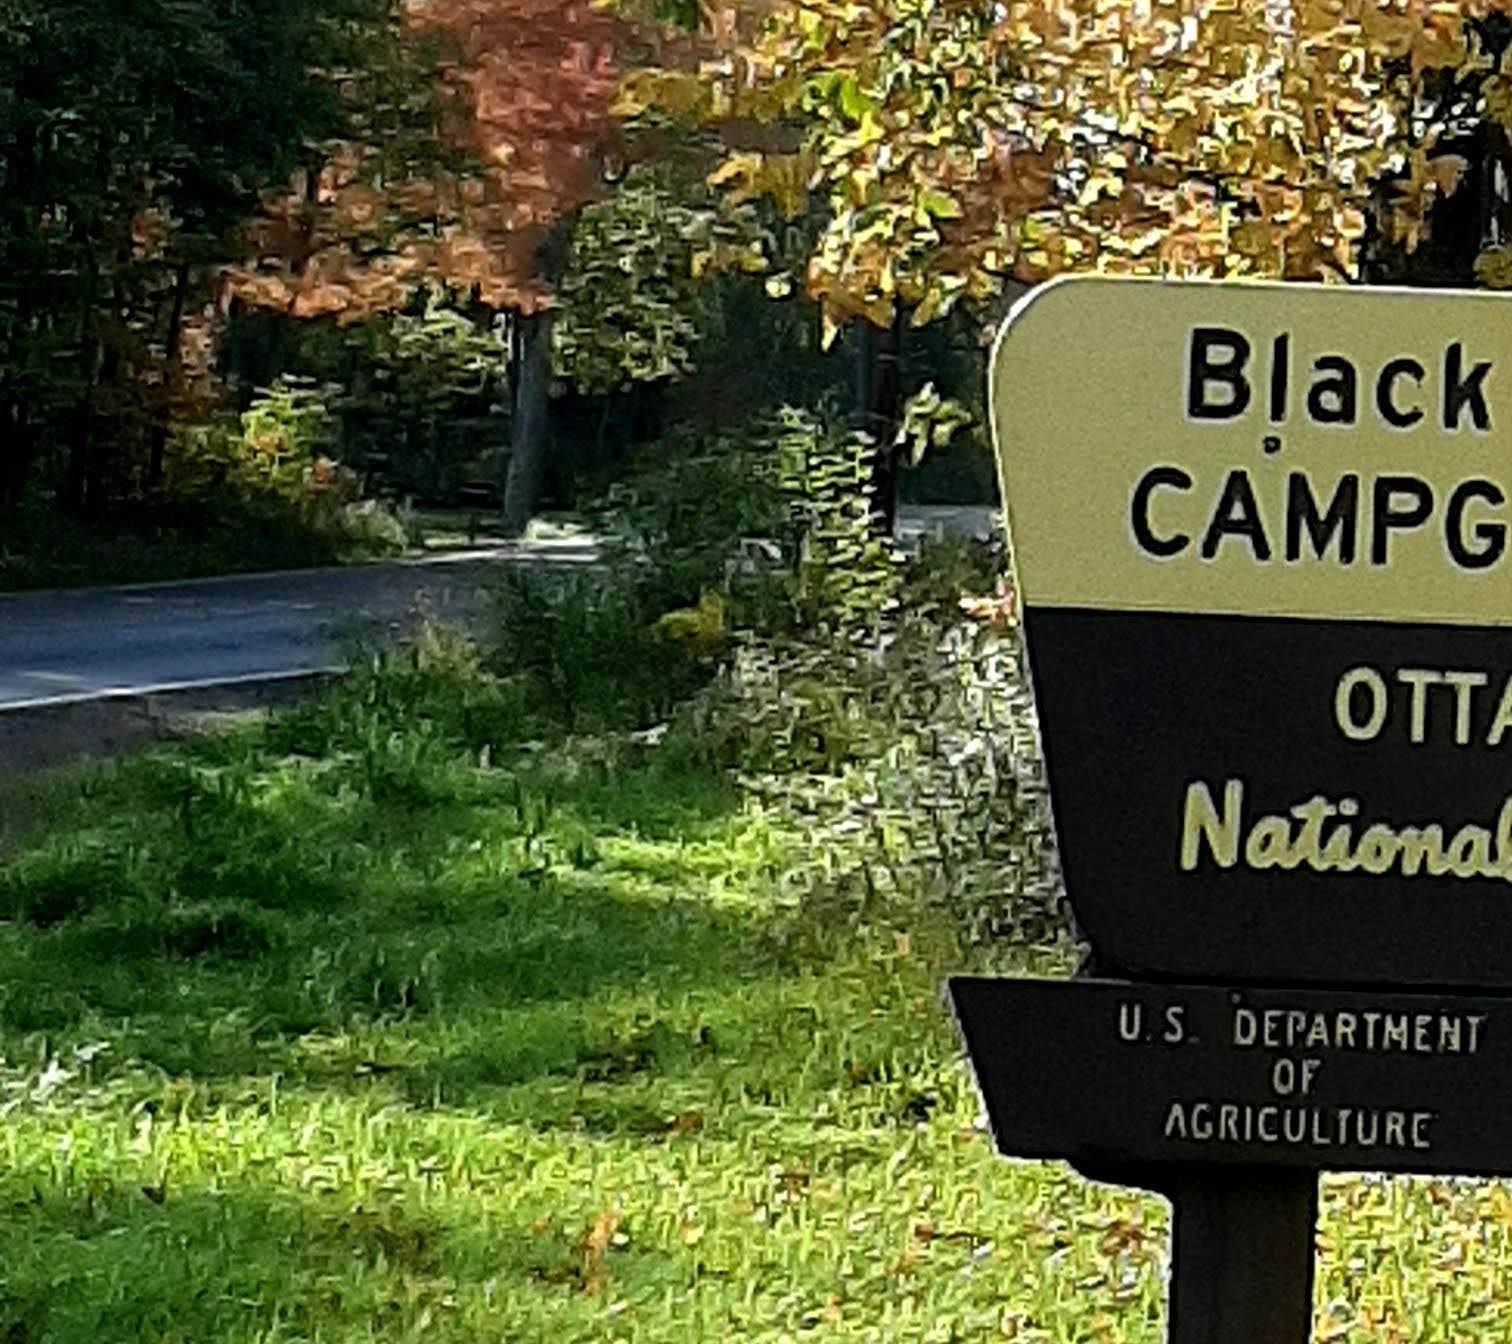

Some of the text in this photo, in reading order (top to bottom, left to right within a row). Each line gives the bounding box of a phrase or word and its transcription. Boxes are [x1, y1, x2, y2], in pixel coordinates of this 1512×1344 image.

[1187, 327, 1493, 431] Black
[1234, 1008, 1487, 1053] DEPARTMENT
[1272, 1058, 1321, 1095] OF
[1164, 1102, 1433, 1148] AGRICULTURE
